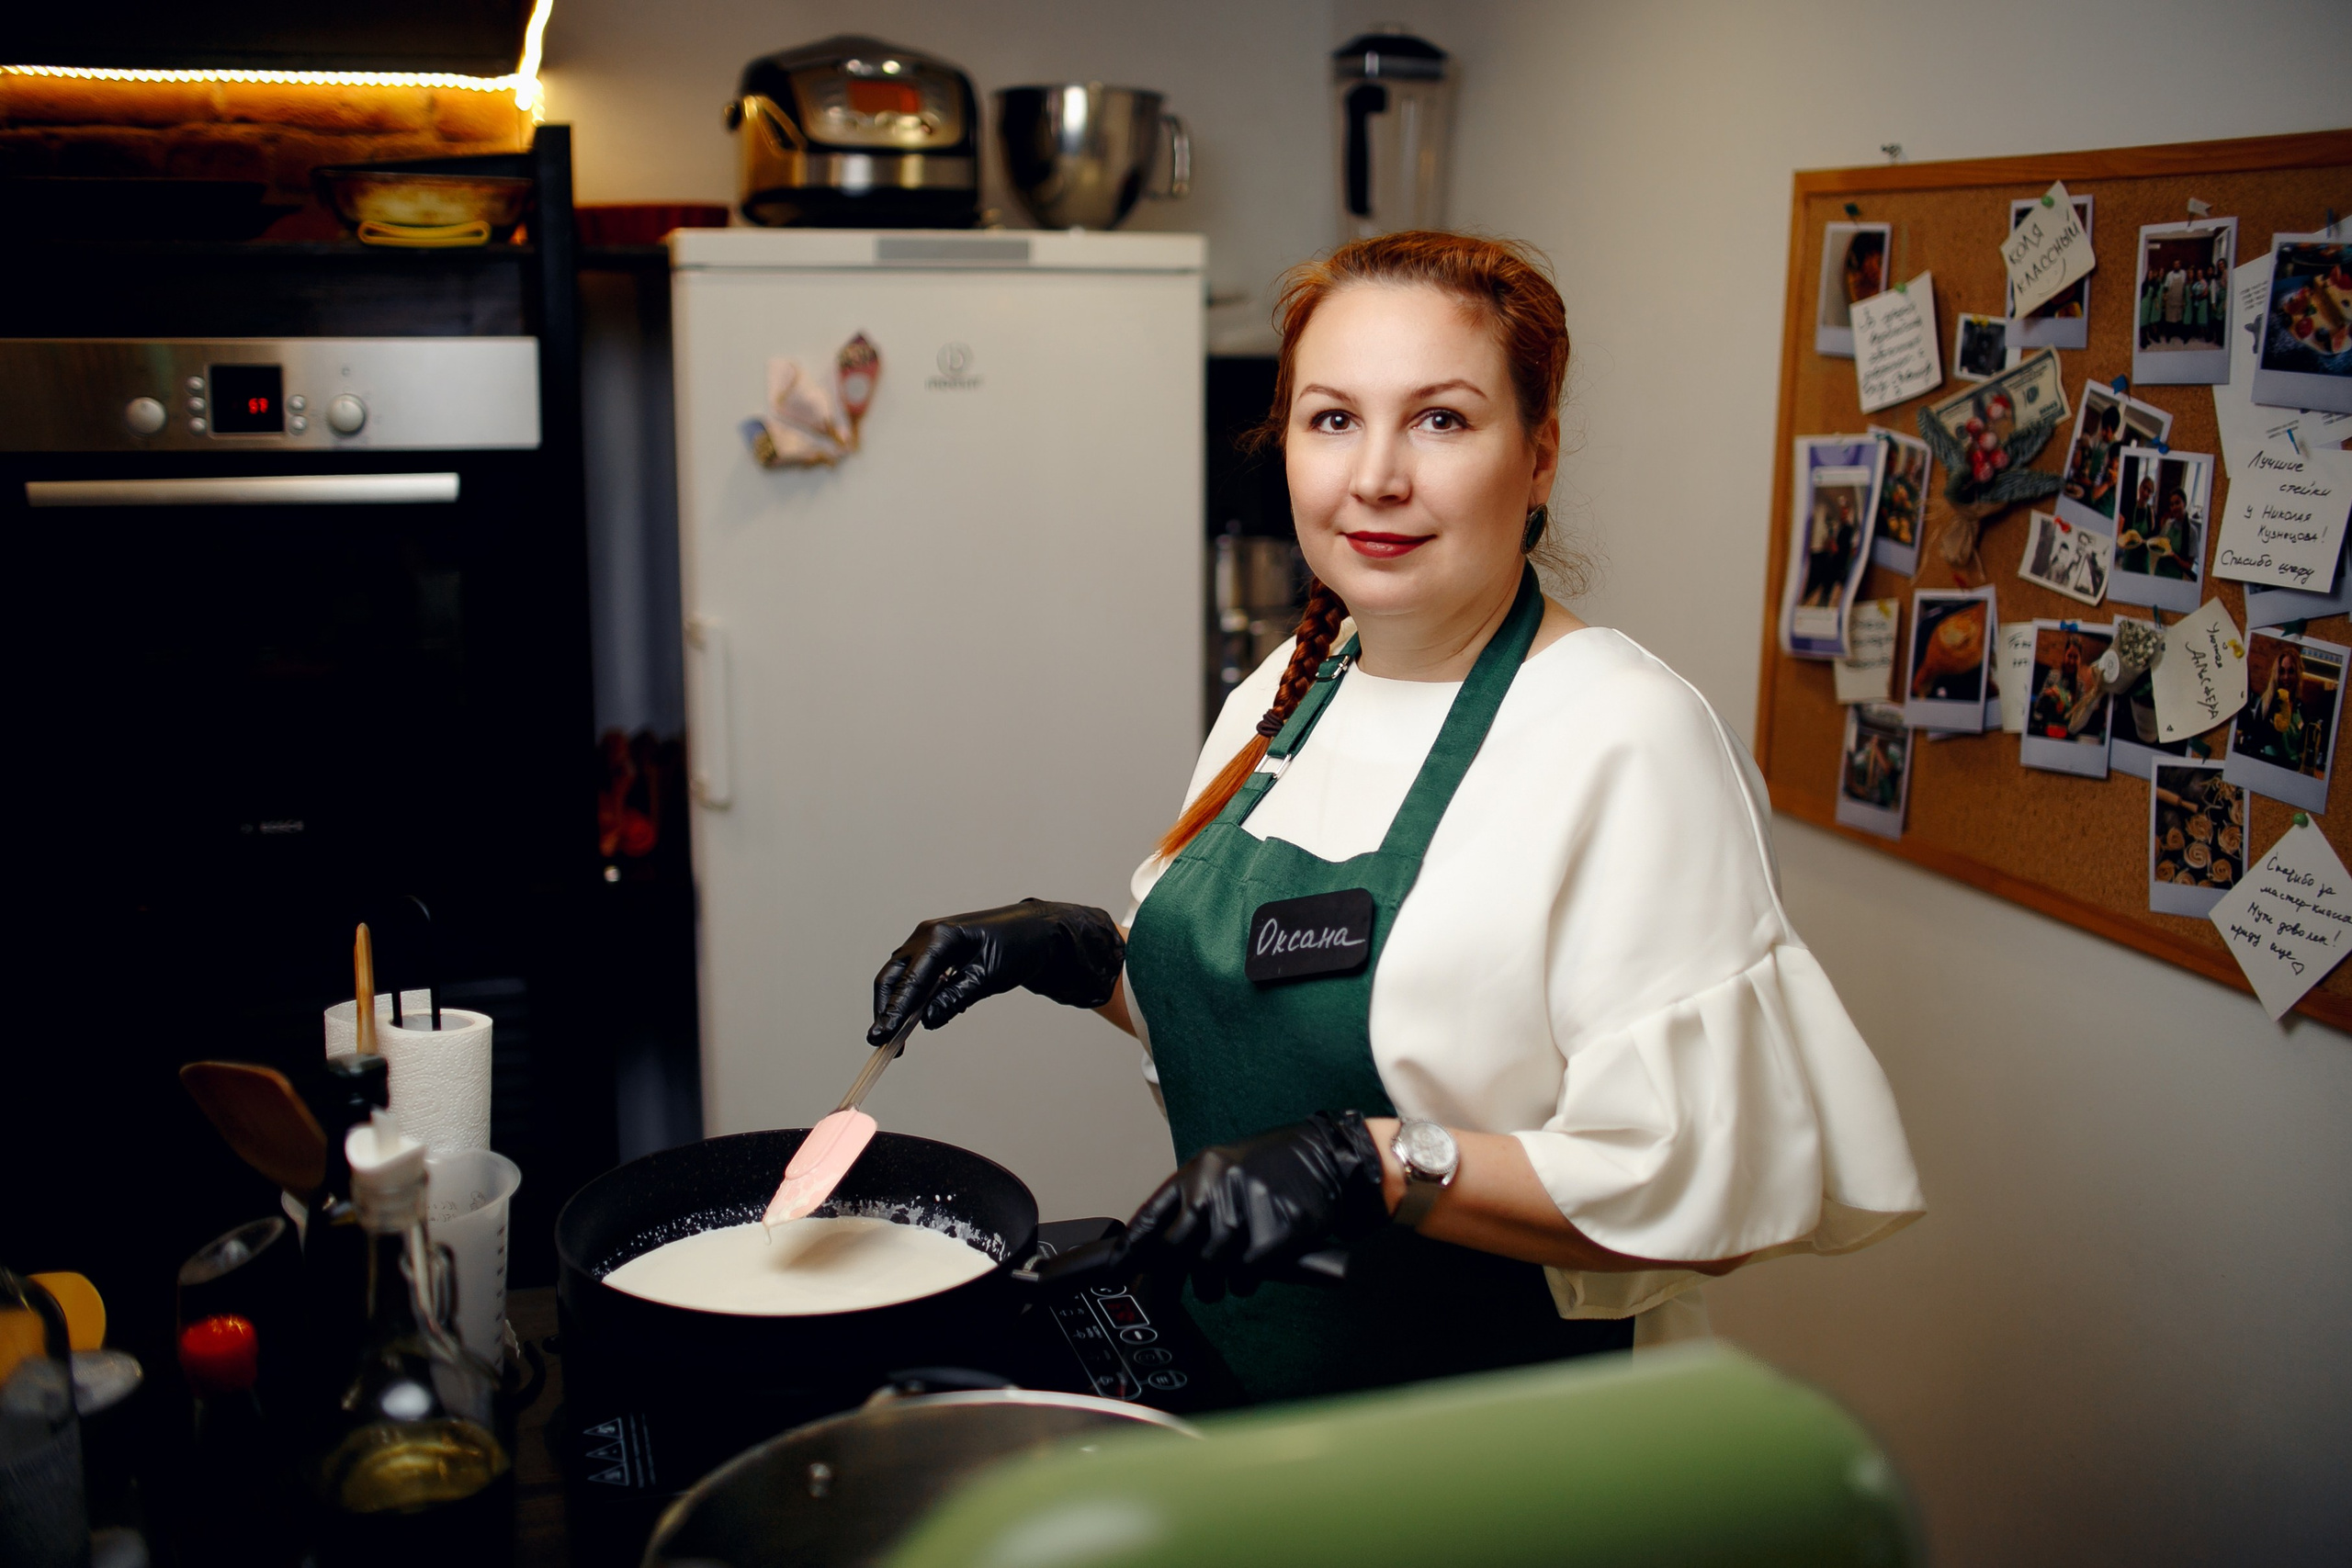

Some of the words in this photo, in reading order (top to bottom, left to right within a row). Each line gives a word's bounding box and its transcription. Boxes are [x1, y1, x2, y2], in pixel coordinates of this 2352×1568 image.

[2247, 450, 2304, 472] Лучшие
[2278, 480, 2333, 497] стейки
[2220, 549, 2273, 566] Спасибо
[1256, 918, 1366, 956] Оксана
